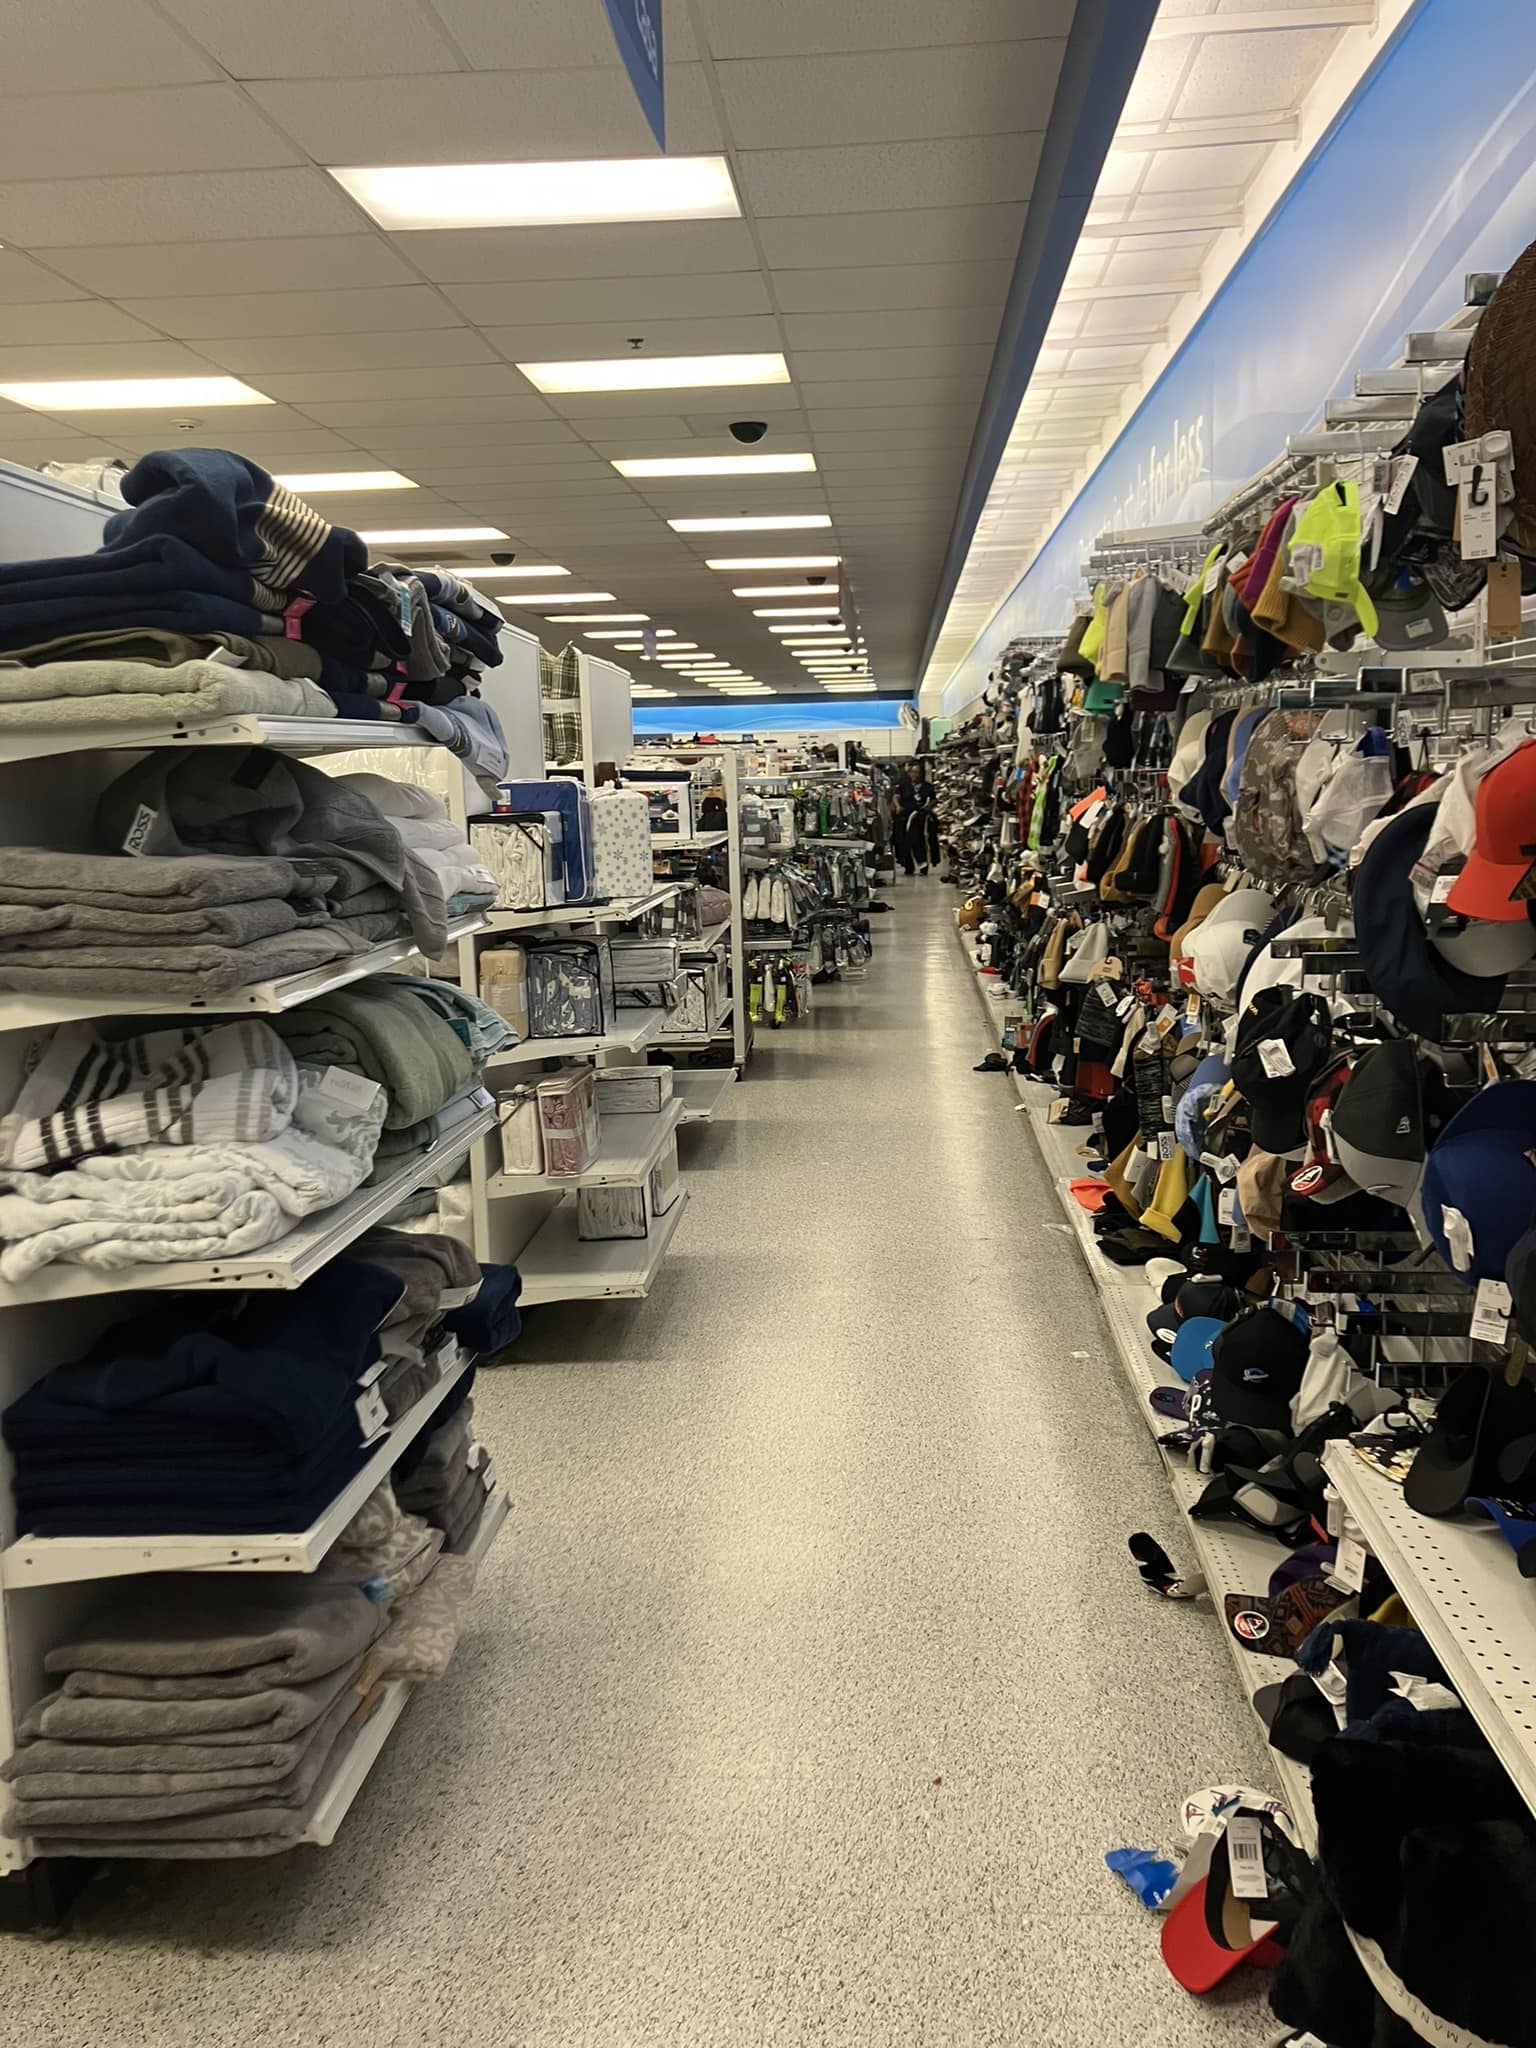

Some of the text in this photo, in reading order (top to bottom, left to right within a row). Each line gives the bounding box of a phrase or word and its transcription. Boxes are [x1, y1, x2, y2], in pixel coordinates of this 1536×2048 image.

[1149, 445, 1170, 519] for
[1173, 415, 1203, 497] less
[128, 812, 151, 849] ROSS
[1160, 1135, 1169, 1158] ROSS
